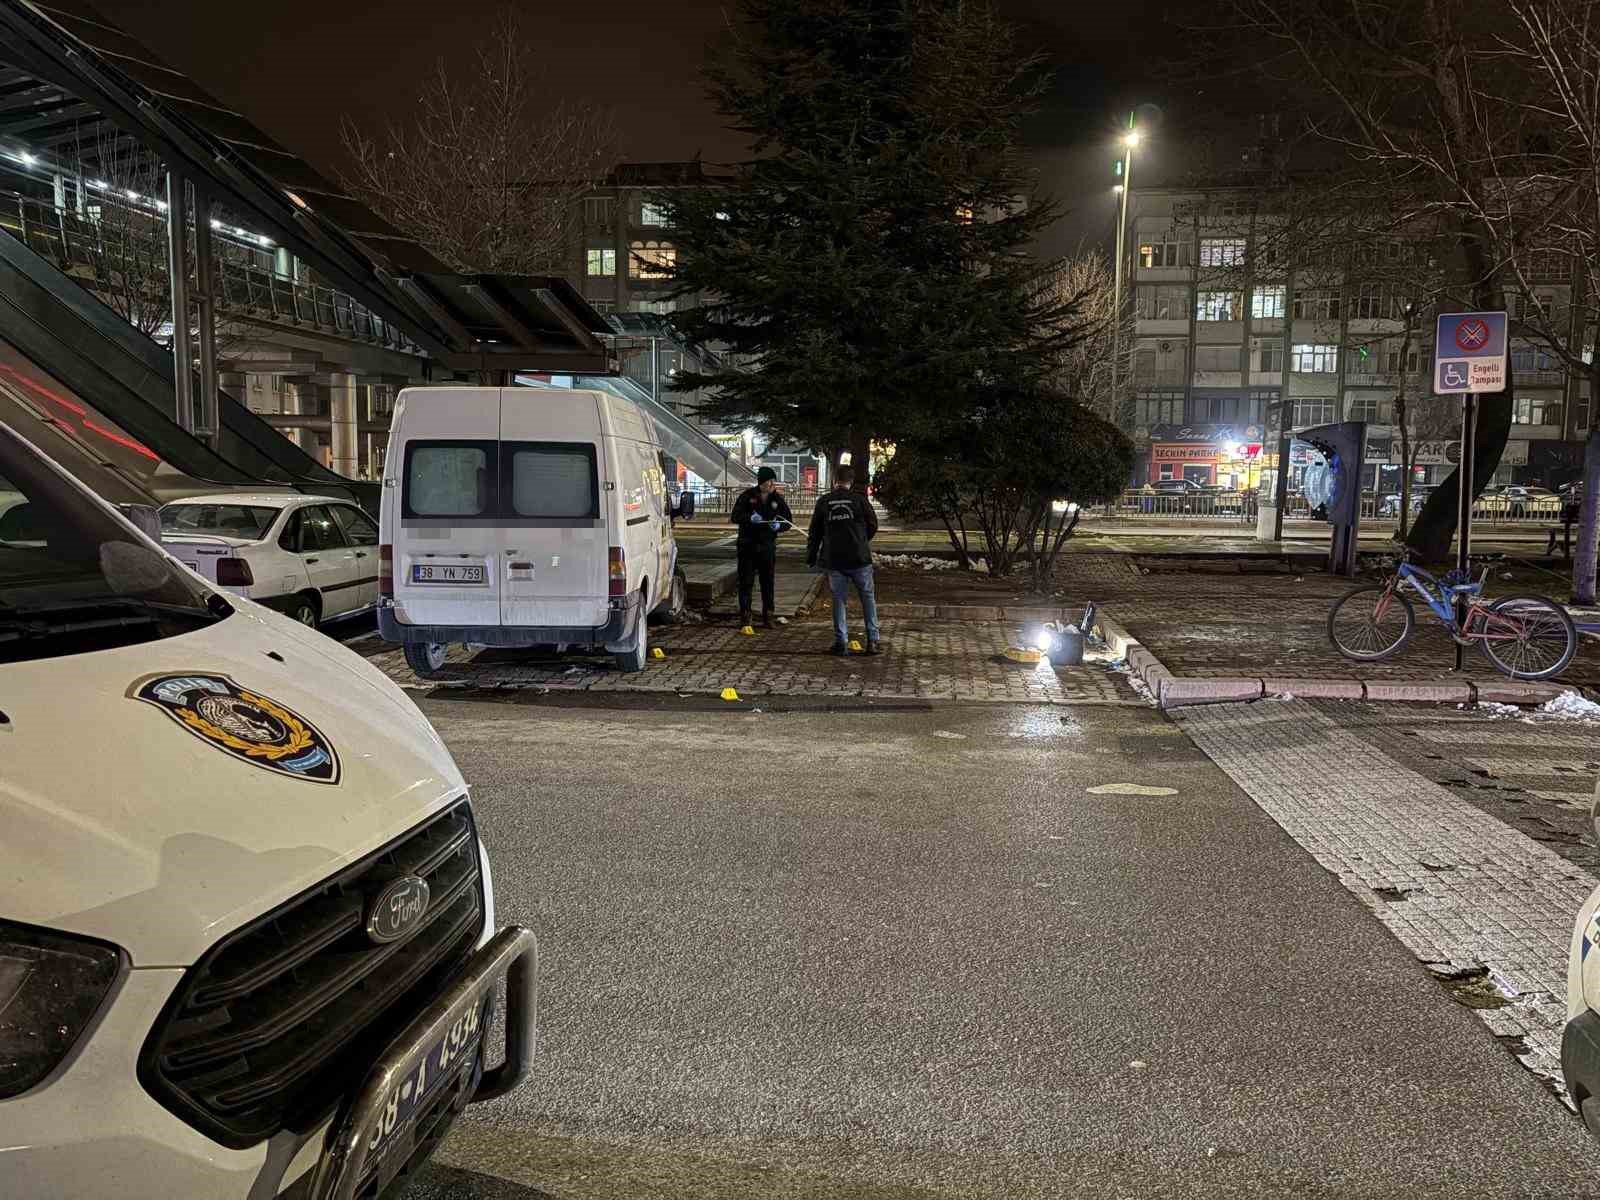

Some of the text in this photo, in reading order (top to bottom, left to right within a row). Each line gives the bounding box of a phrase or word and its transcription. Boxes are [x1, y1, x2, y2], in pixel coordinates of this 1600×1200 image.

[1473, 363, 1499, 374] Engelli
[421, 567, 480, 579] 38 YN 759
[390, 886, 421, 928] Ford
[413, 1057, 426, 1105] A
